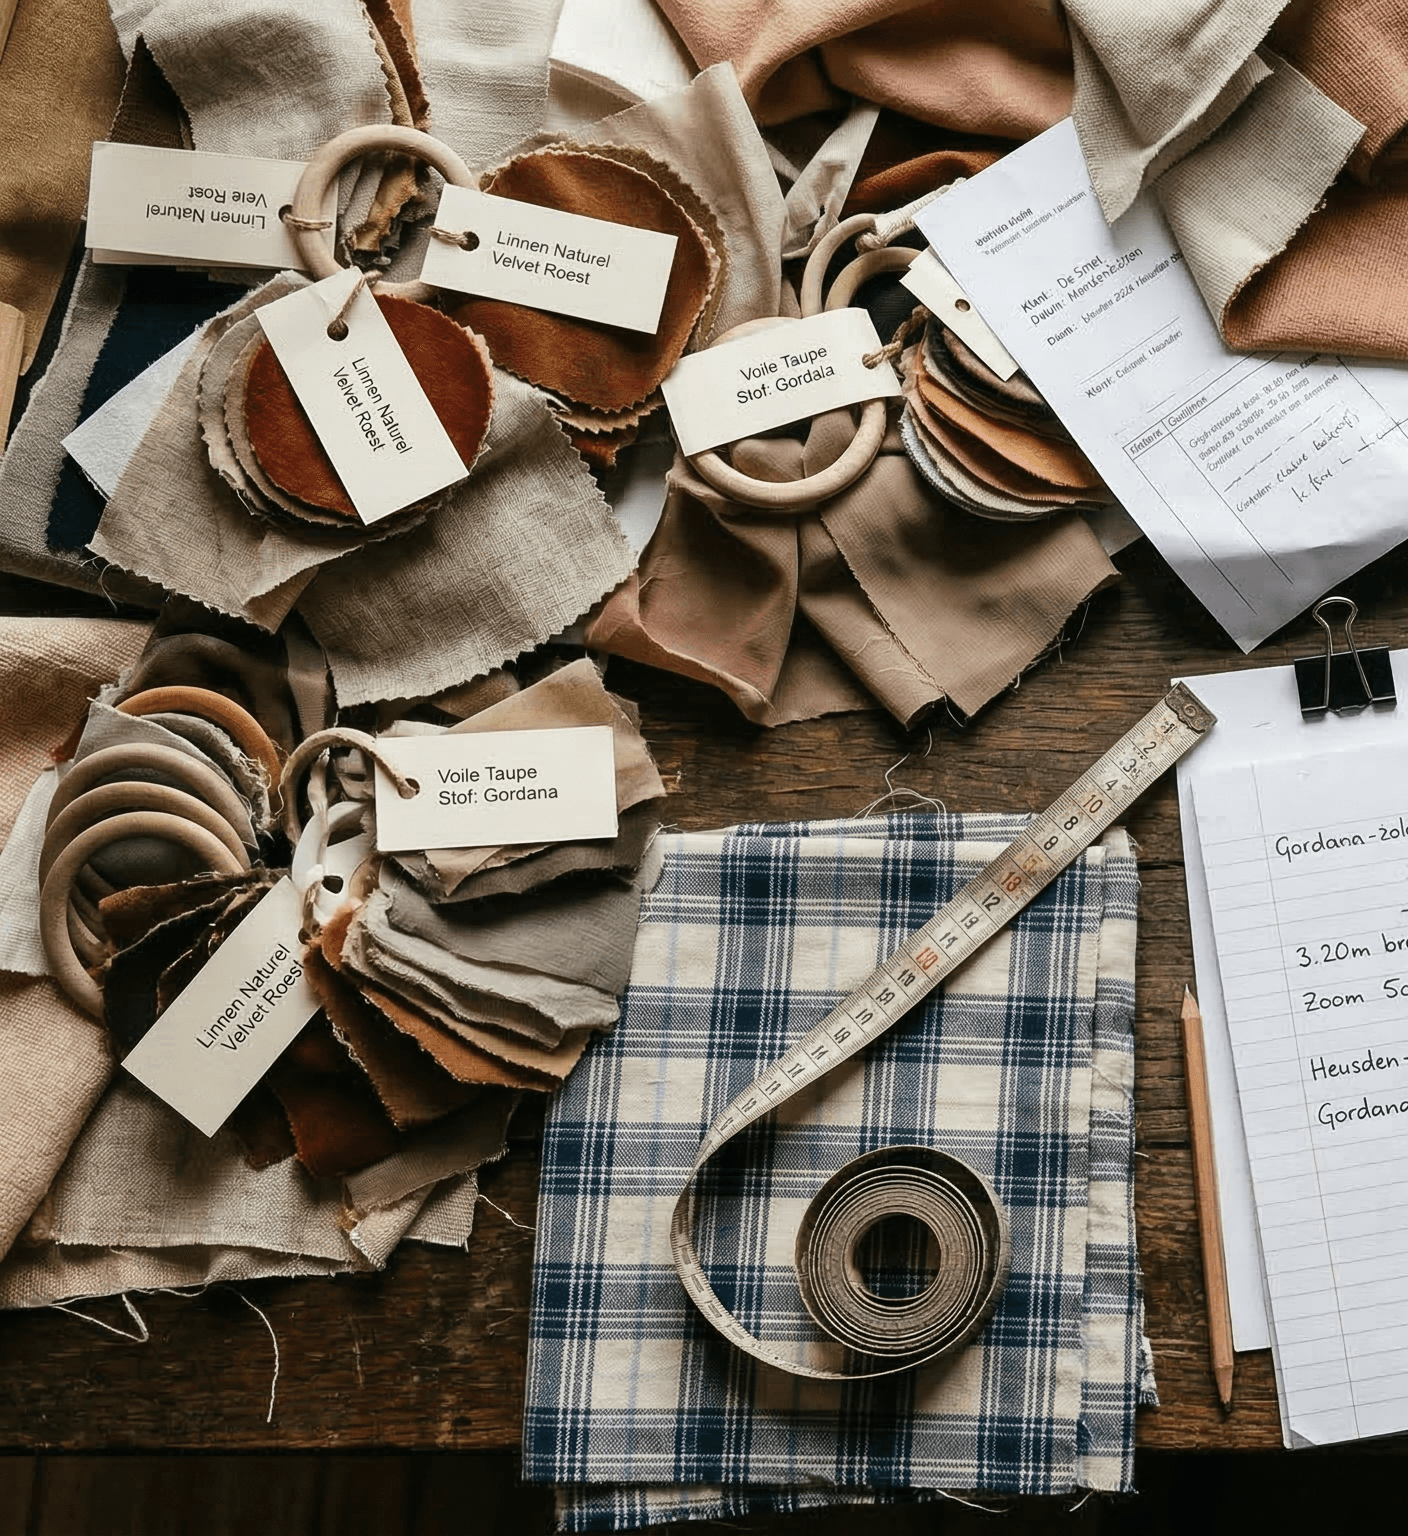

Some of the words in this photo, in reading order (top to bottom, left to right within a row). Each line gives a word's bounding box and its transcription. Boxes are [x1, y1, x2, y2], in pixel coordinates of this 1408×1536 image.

[188, 187, 227, 204] Rost
[146, 203, 205, 223] Naturel
[210, 210, 266, 229] Linnen
[497, 231, 549, 254] Linnen
[554, 243, 611, 268] Naturel
[492, 251, 540, 274] Velvet
[544, 262, 591, 285] Roest
[740, 362, 778, 381] Voile
[780, 347, 827, 369] Taupe
[352, 357, 383, 404] Linnen
[333, 366, 363, 411] Velvet
[355, 410, 386, 452] Roest
[1143, 741, 1157, 754] 2
[437, 768, 480, 784] Voile
[484, 766, 538, 783] Taupe
[1106, 778, 1119, 791] 4
[438, 789, 478, 805] Stof:
[483, 786, 558, 802] Gordana
[1083, 794, 1103, 814] 10
[1063, 815, 1079, 831] 8
[981, 891, 1001, 912] 12
[1296, 942, 1371, 968] 3.20m
[196, 999, 245, 1049] Linnen
[239, 943, 290, 999] Naturel
[220, 1004, 270, 1051] Velvet
